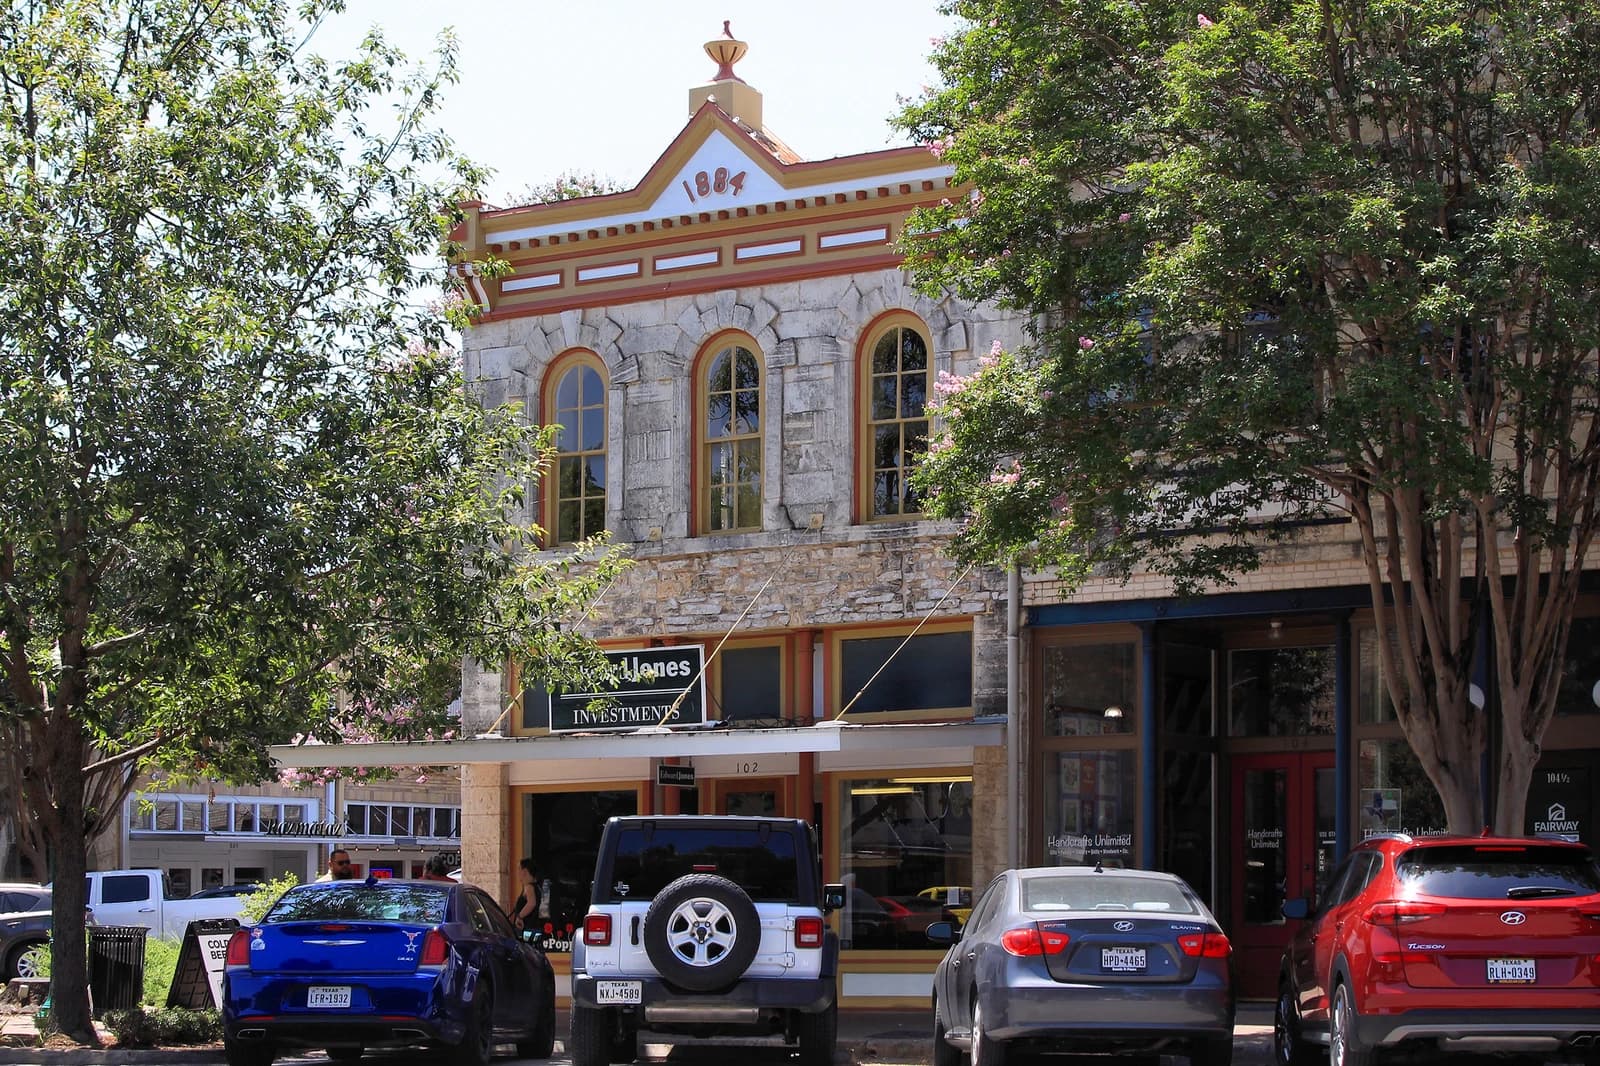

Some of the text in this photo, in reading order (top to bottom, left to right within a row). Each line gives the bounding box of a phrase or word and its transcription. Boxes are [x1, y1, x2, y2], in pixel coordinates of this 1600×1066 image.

[682, 166, 746, 203] 1884
[573, 704, 680, 725] INVESTMENTS
[736, 762, 758, 773] 102
[1534, 821, 1579, 831] FAIRWAY
[1247, 828, 1283, 840] Handcrafts
[1047, 834, 1131, 848] Handcrafts Unlimited
[1251, 839, 1280, 849] Unlimited
